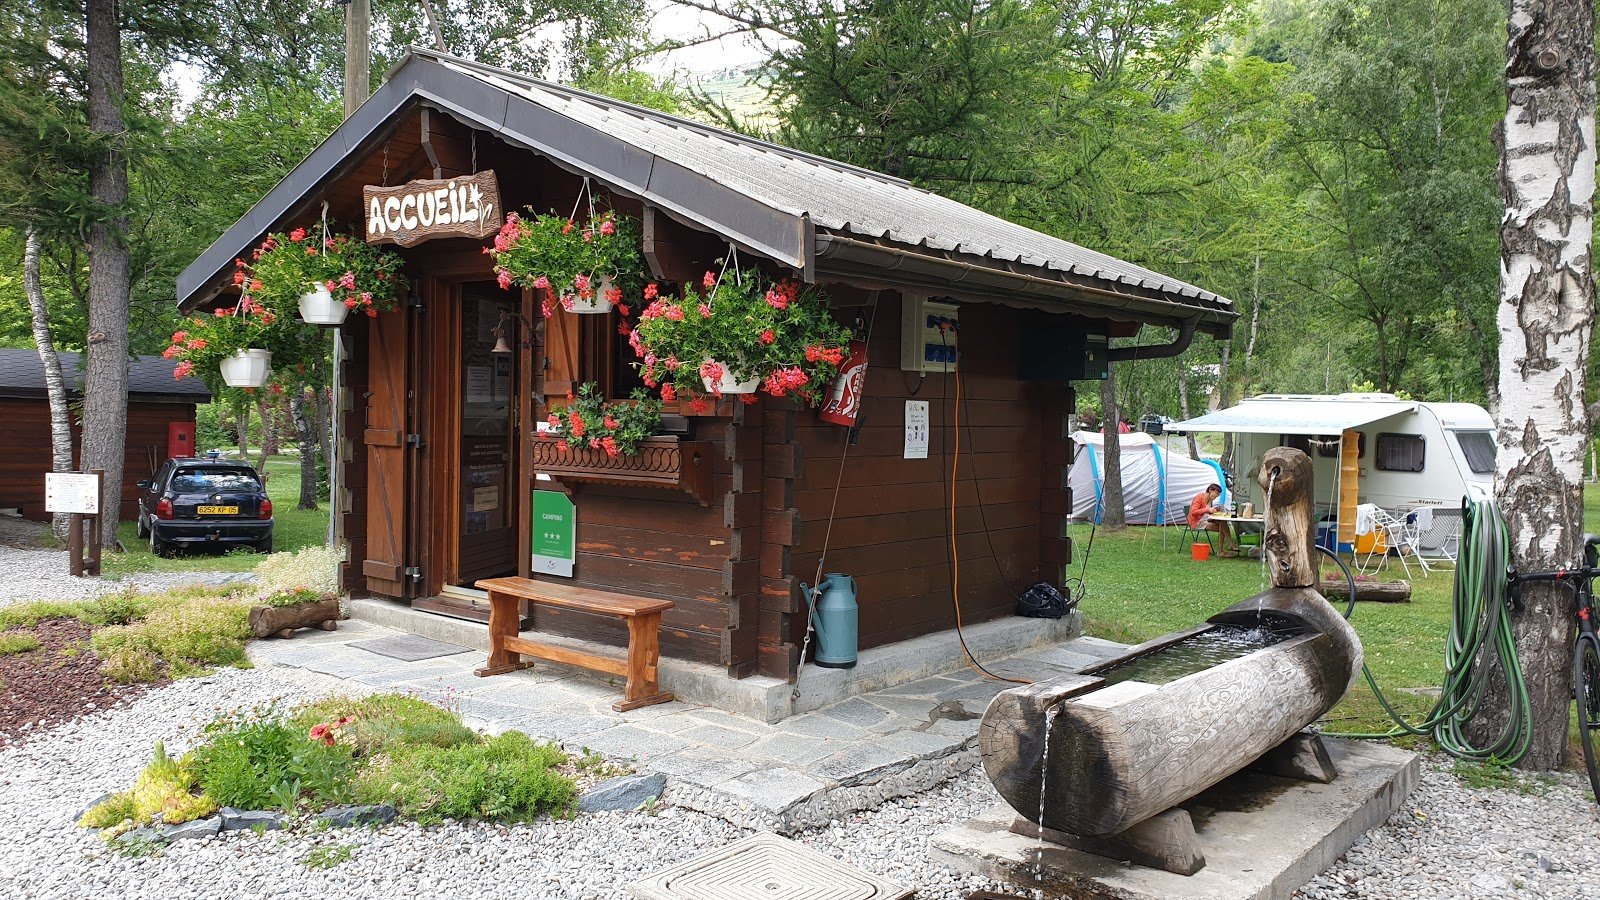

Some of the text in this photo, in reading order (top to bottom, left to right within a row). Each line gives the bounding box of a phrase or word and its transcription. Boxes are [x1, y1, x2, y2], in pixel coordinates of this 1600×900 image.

[198, 506, 237, 514] 6252 KP 05
[542, 513, 563, 521] CAMPING
